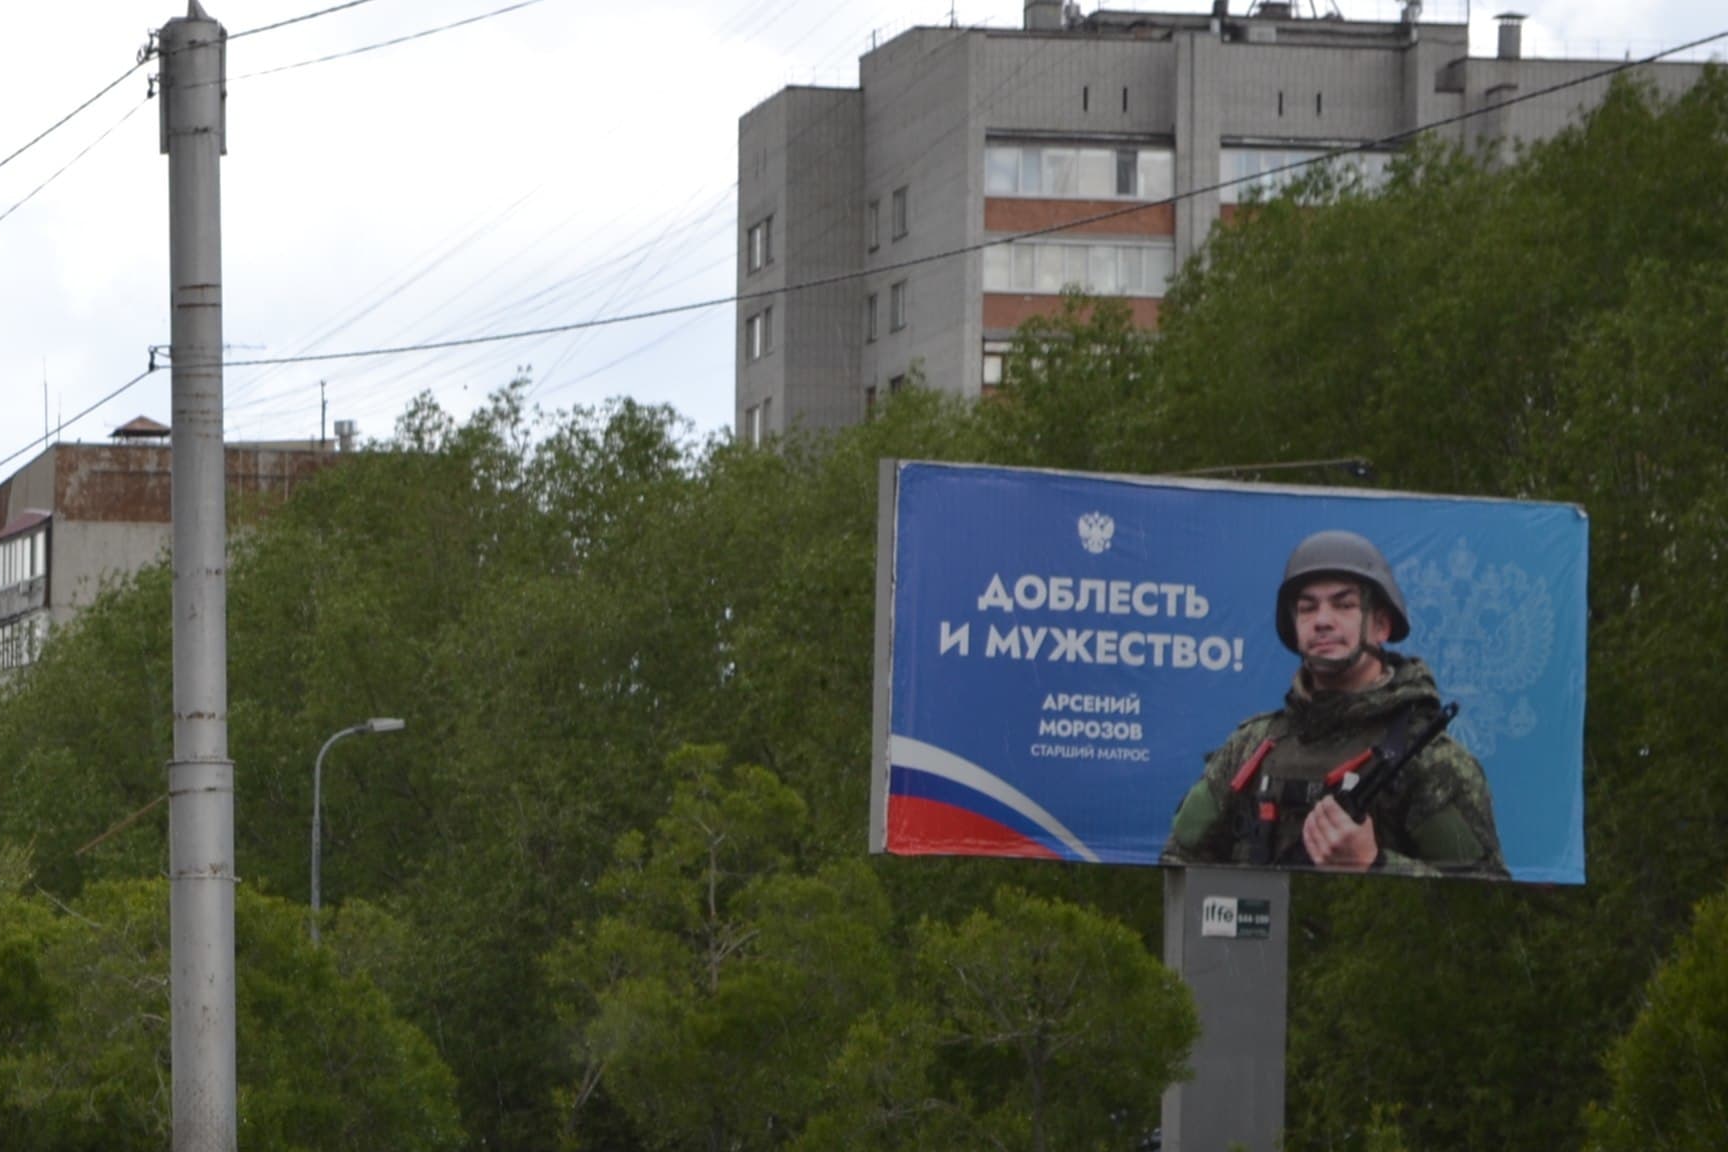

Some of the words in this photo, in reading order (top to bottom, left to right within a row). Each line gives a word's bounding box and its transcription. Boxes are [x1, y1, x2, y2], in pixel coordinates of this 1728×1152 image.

[977, 572, 1210, 619] ДОБЛЕСТЬ
[939, 621, 970, 657] И
[985, 623, 1245, 673] МУЖЕСТВО!
[1041, 693, 1141, 715] АРСЕНИЙ
[1038, 718, 1143, 741] МОРОЗОВ
[1030, 743, 1095, 760] СТАРШИЙ
[1097, 747, 1151, 762] МАТРОС
